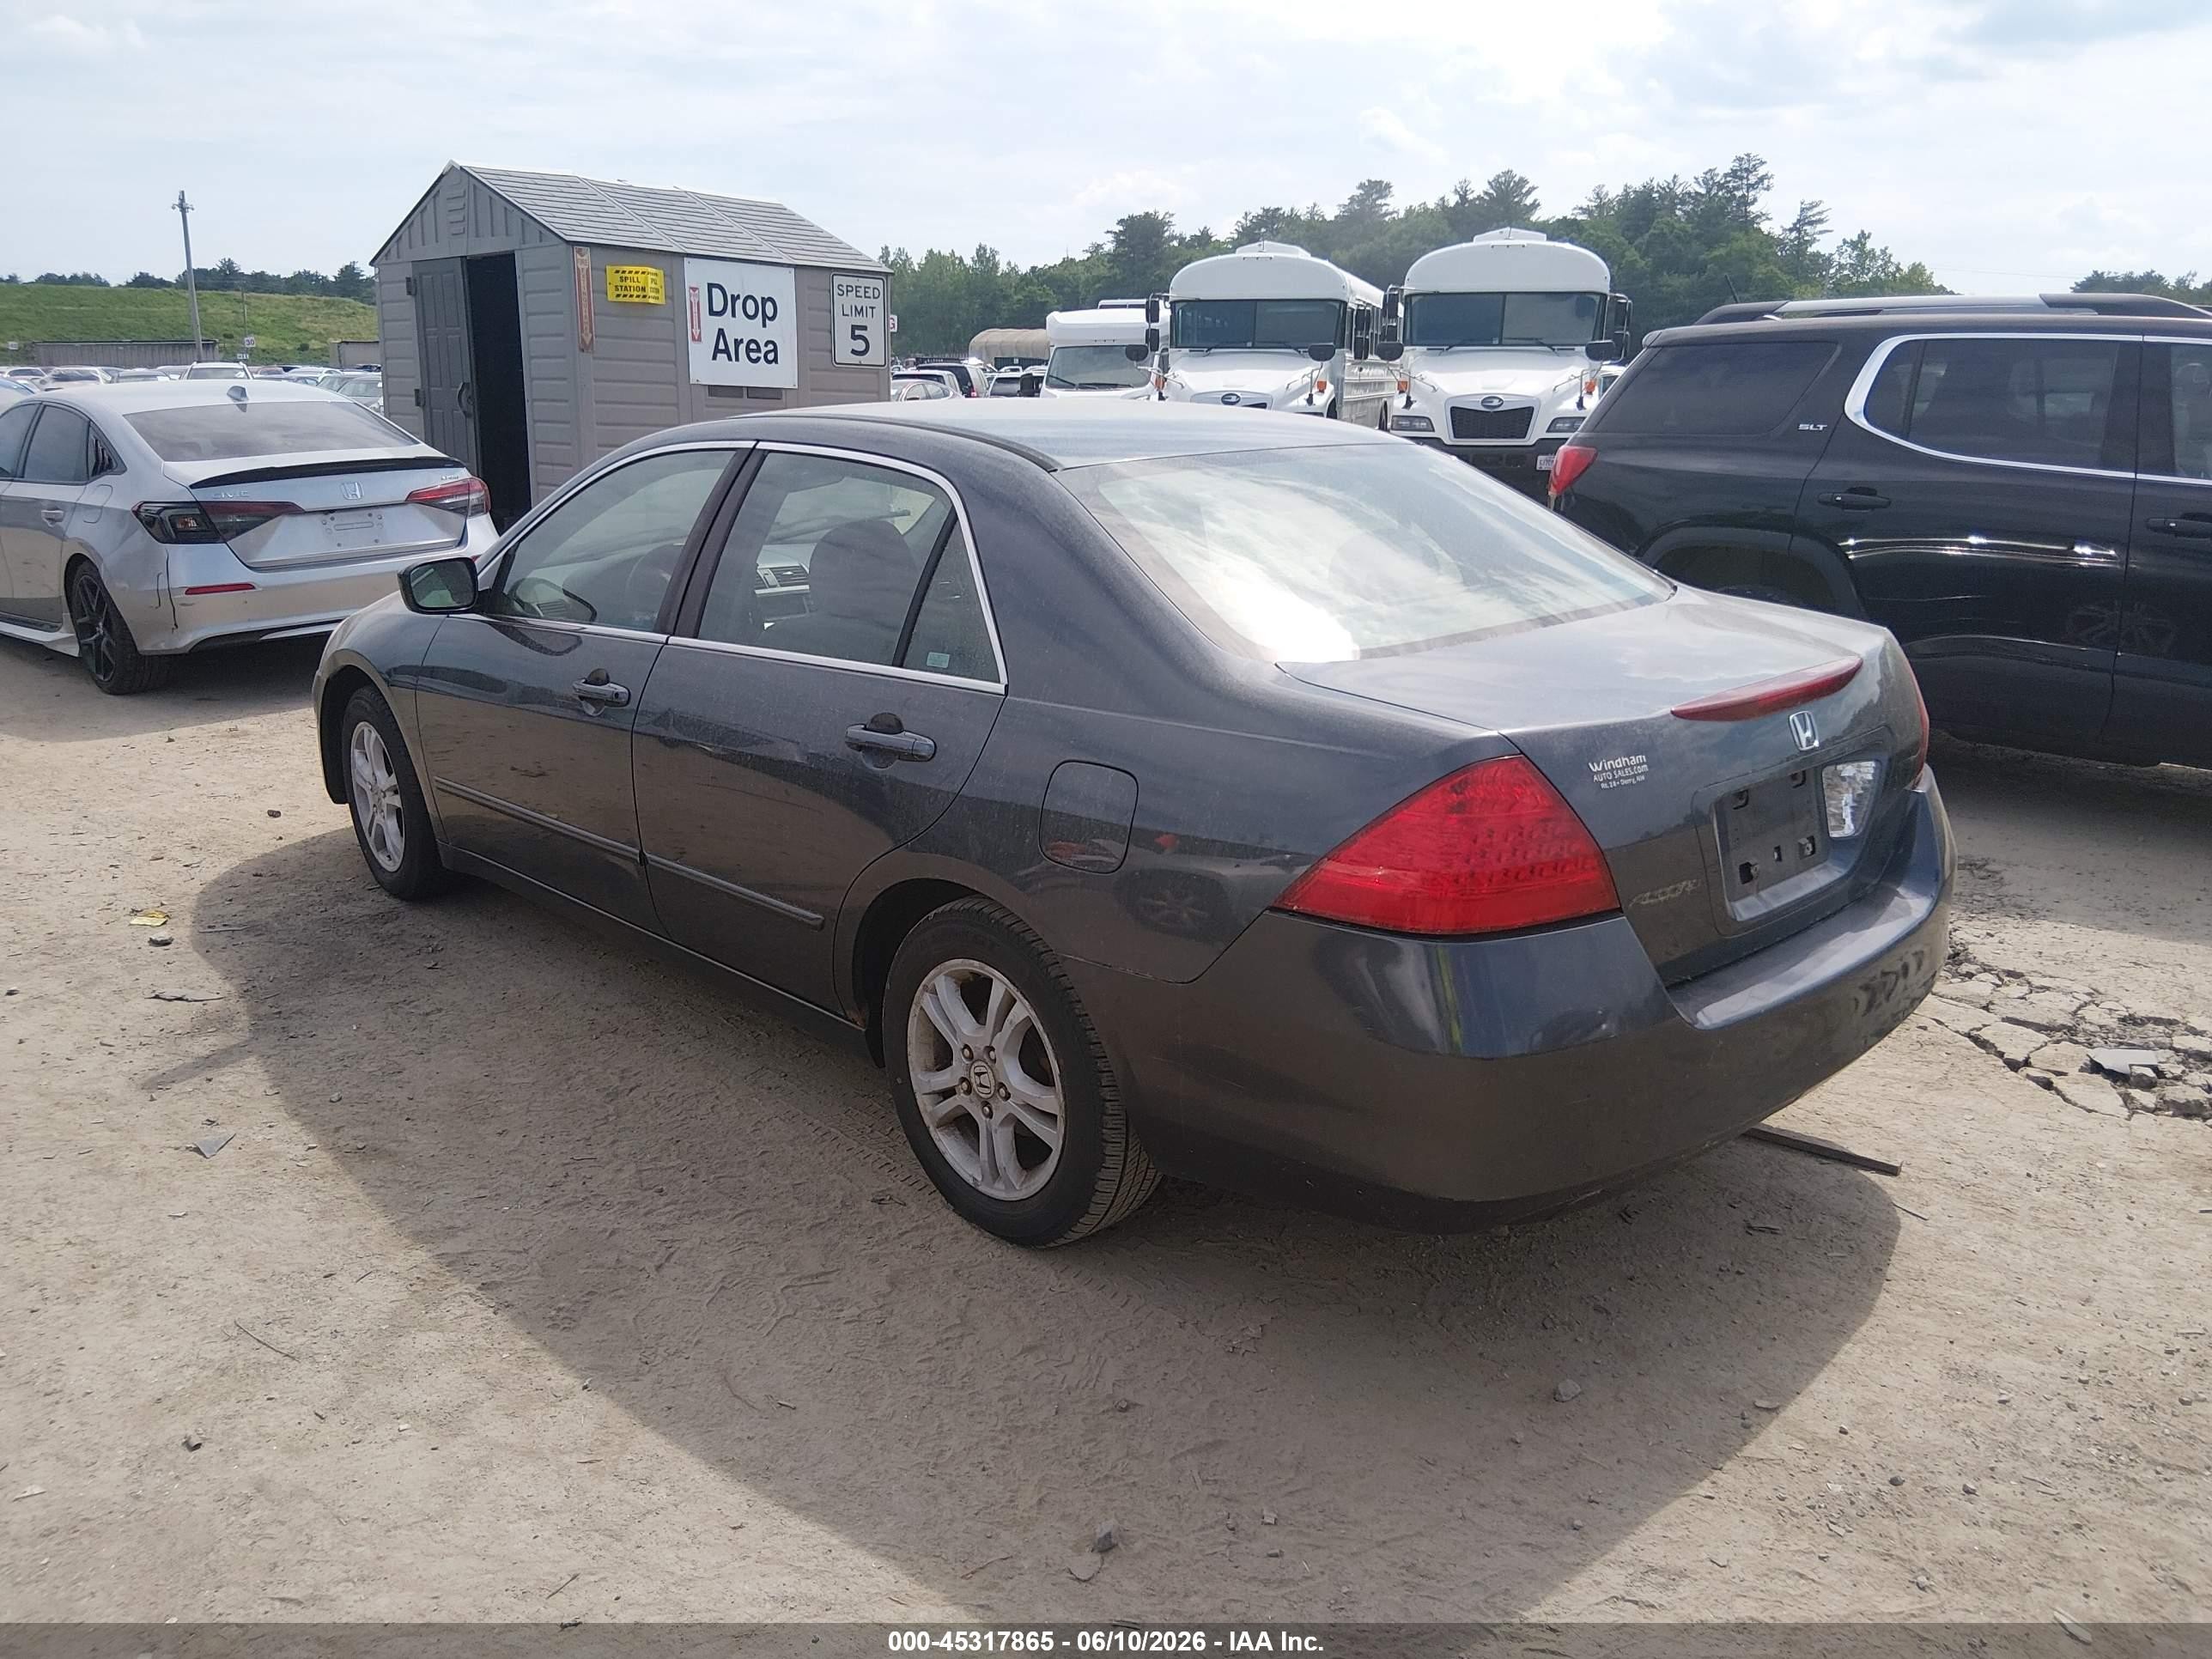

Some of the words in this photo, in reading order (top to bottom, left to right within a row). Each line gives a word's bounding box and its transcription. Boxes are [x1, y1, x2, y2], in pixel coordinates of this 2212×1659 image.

[837, 284, 881, 300] SPEED
[707, 283, 778, 328] Drop
[842, 304, 876, 319] LIMIT
[711, 328, 779, 364] Area
[850, 324, 871, 356] 5
[1588, 755, 1647, 772] Windham
[1593, 772, 1613, 782] AUTO
